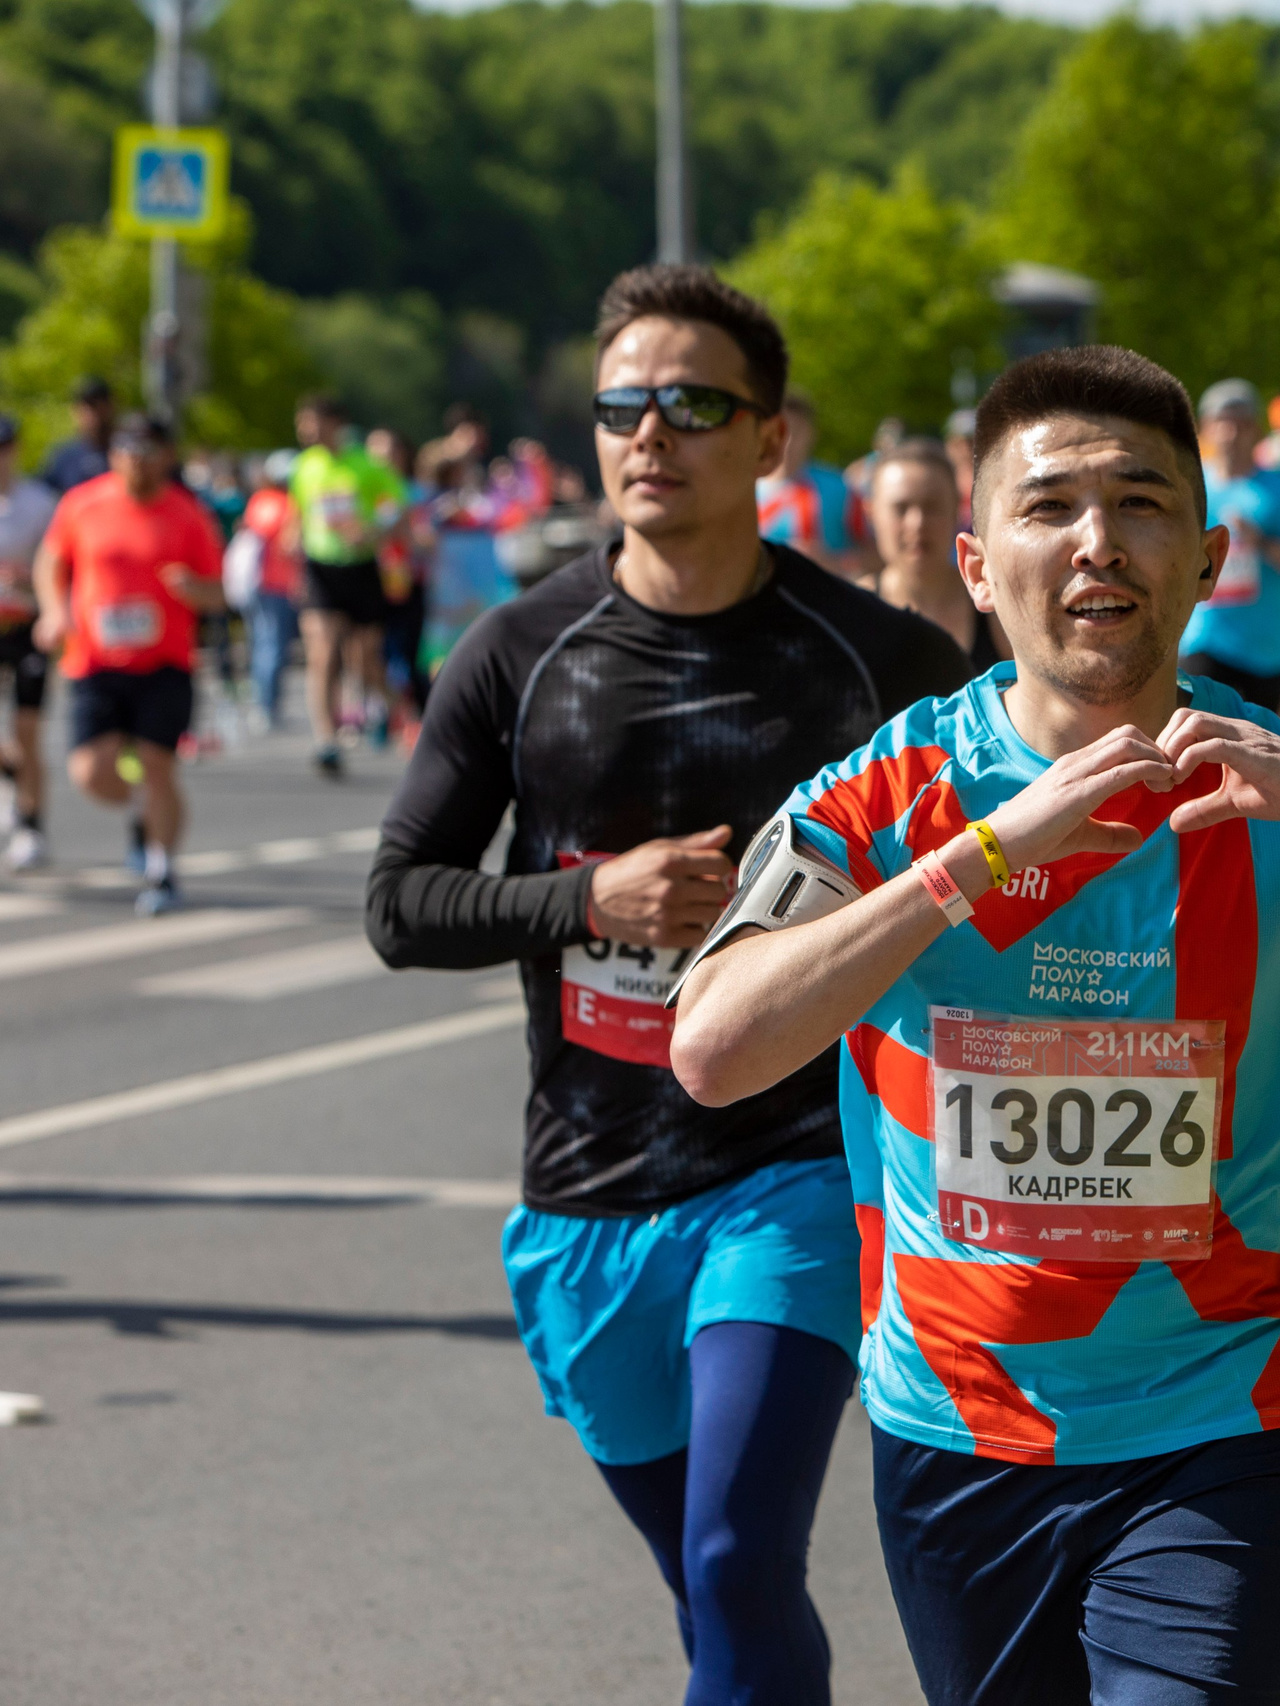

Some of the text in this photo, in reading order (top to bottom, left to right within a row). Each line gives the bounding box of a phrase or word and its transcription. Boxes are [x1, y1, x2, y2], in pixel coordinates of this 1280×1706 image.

[984, 841, 998, 856] NIKE
[1033, 941, 1171, 968] МОСКОВСКИЙ
[1031, 965, 1086, 984] ПОЛУ
[1029, 984, 1129, 1006] МАРАФОН
[577, 989, 597, 1027] E
[946, 1009, 970, 1019] 13026
[962, 1024, 1061, 1042] МОСКОВСКИЙ
[962, 1040, 1000, 1054] ПОЛУ
[962, 1053, 1032, 1069] МАРАФОН
[1155, 1059, 1189, 1070] 2023
[945, 1083, 1206, 1167] 13026
[1008, 1175, 1133, 1201] КАДРБЕК
[962, 1200, 989, 1240] D
